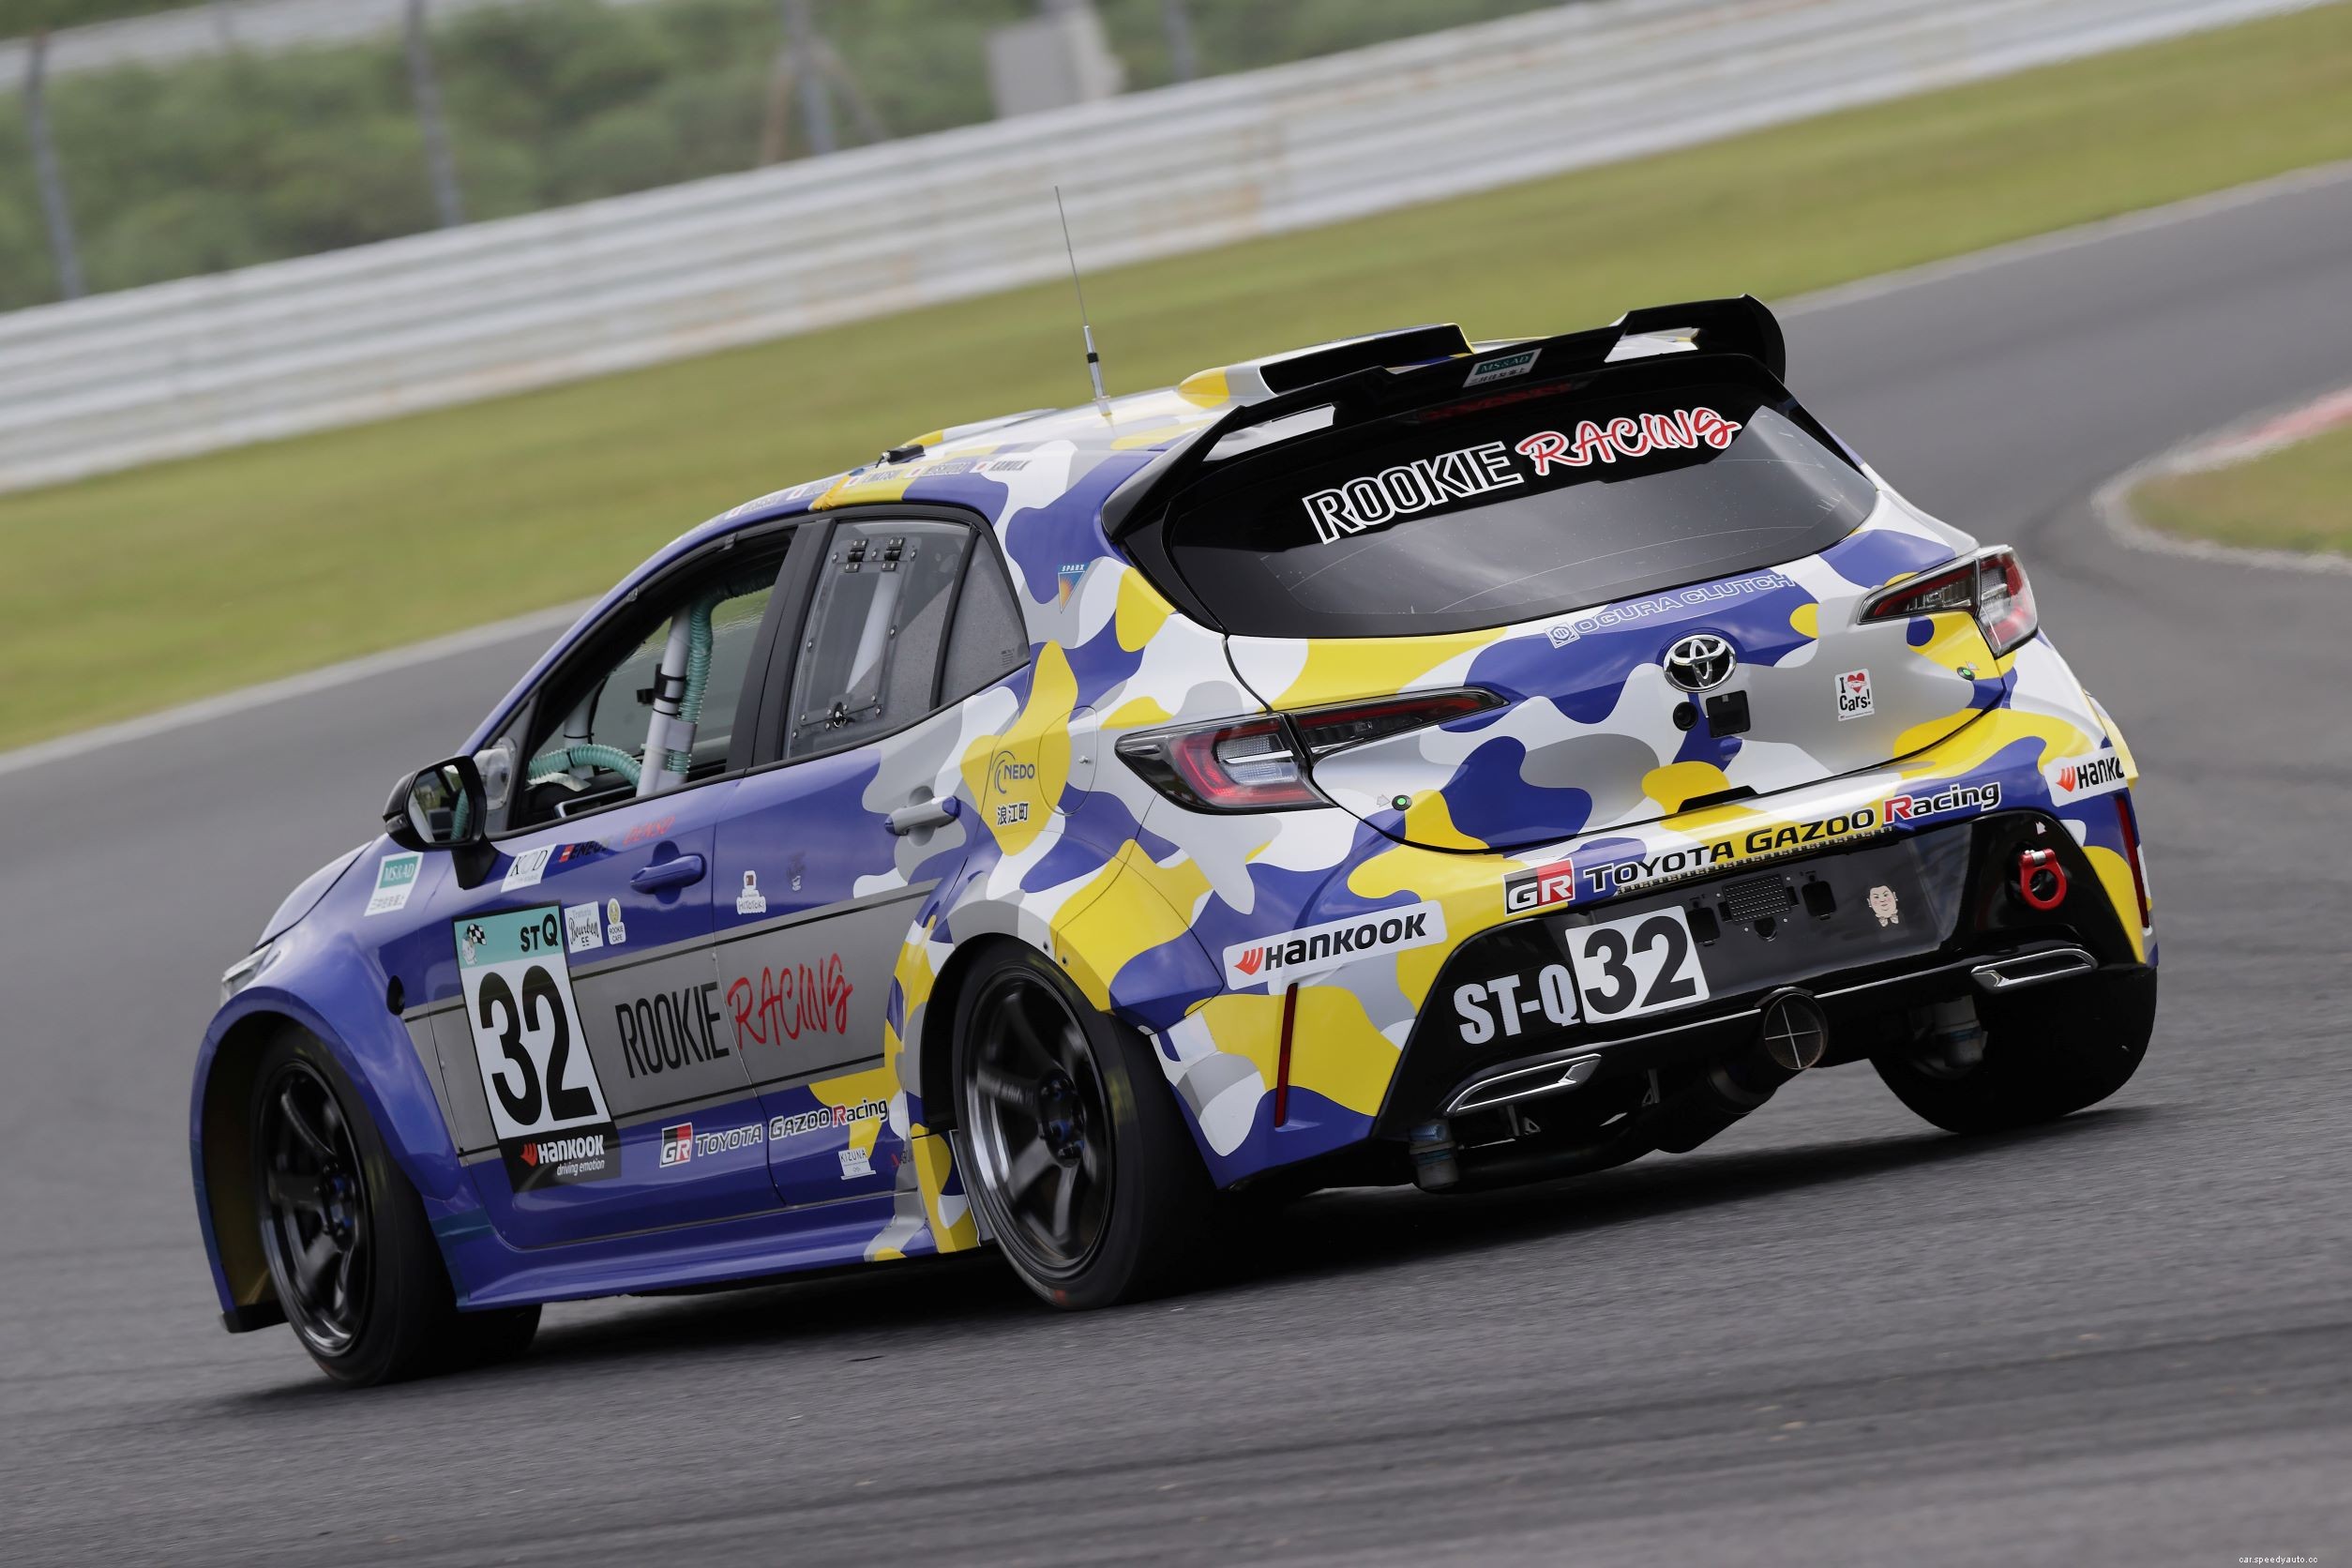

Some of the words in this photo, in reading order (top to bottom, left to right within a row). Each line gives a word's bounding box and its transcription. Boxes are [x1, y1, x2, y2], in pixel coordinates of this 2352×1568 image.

[1303, 441, 1524, 544] ROOKIE
[1515, 407, 1741, 475] RACING
[1573, 597, 1680, 634] OGURA
[1681, 574, 1796, 605] CLUTCH
[1839, 676, 1846, 694] I
[1839, 688, 1871, 711] Cars!
[1004, 764, 1035, 779] NEDO
[997, 803, 1029, 825] 浪江町
[1508, 874, 1573, 908] GR
[1585, 840, 1734, 893] TOYOTA
[1745, 808, 1875, 852] GAZOO
[1883, 782, 2001, 824] Racing
[384, 863, 415, 881] MS&AD
[568, 917, 600, 945] Bourbon
[609, 926, 624, 934] ROOKIE
[1453, 964, 1581, 1045] ST-Q
[1584, 914, 1697, 1015] 32
[615, 981, 730, 1078] ROOKIE
[728, 953, 853, 1048] RACING
[478, 965, 598, 1125] 32
[696, 1124, 762, 1156] TOYOTA
[832, 1099, 888, 1128] Racing
[556, 1163, 579, 1176] driving
[579, 1158, 605, 1172] emotion
[840, 1149, 867, 1163] KIZUNA
